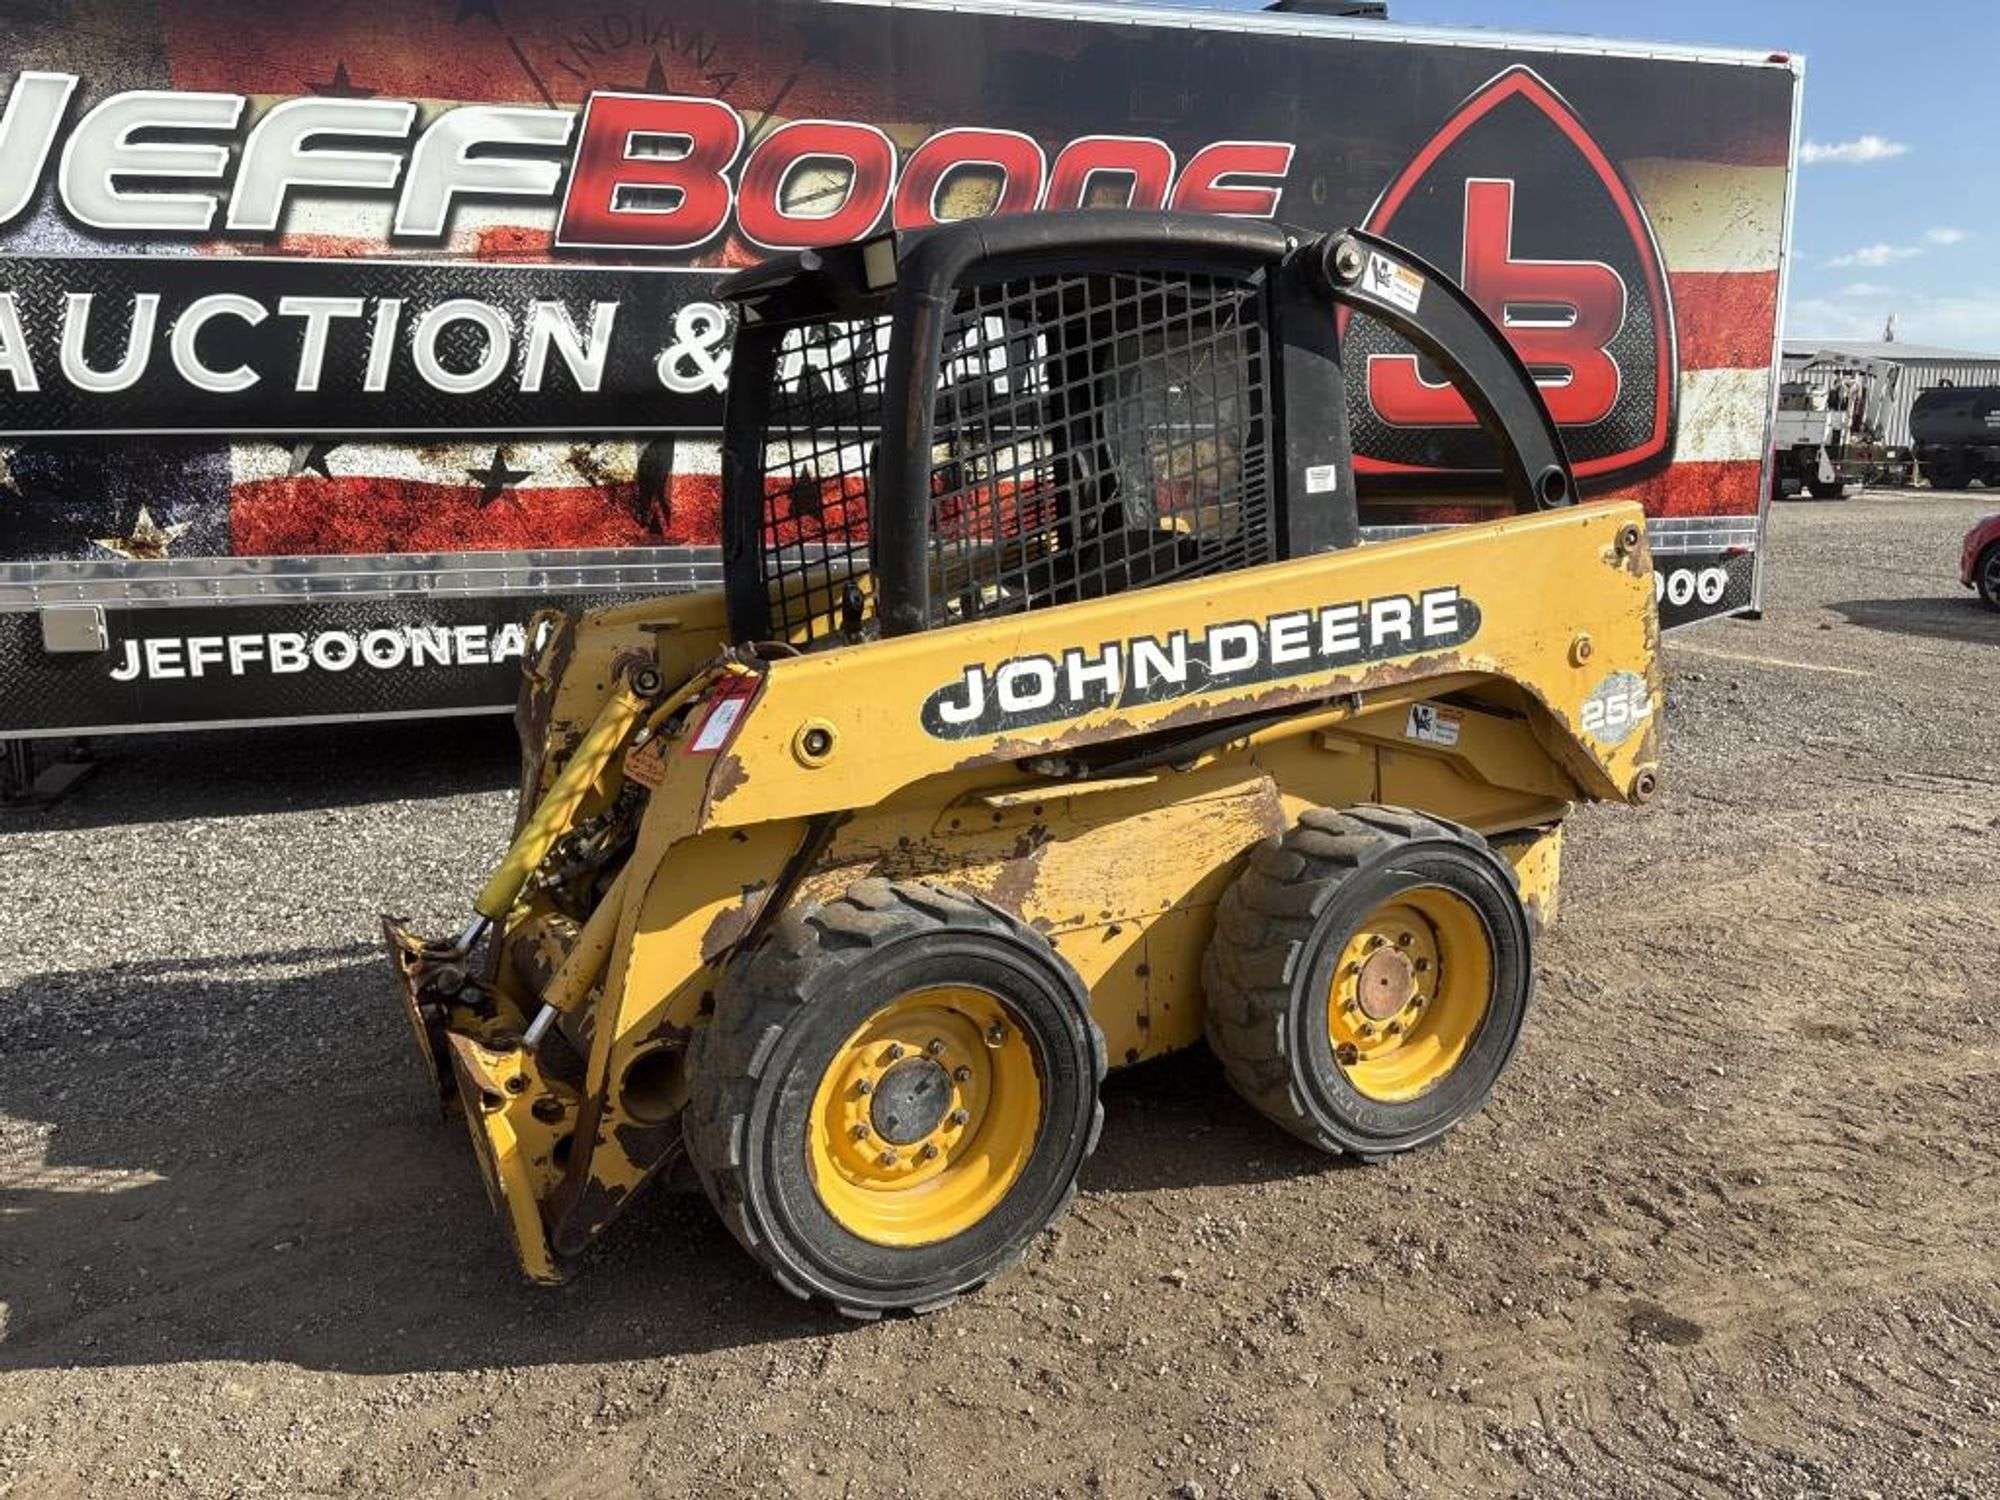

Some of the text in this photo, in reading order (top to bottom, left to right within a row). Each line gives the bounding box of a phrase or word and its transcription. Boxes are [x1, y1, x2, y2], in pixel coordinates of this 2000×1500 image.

[656, 302, 730, 393] &
[938, 588, 1460, 724] JOHN DEERE
